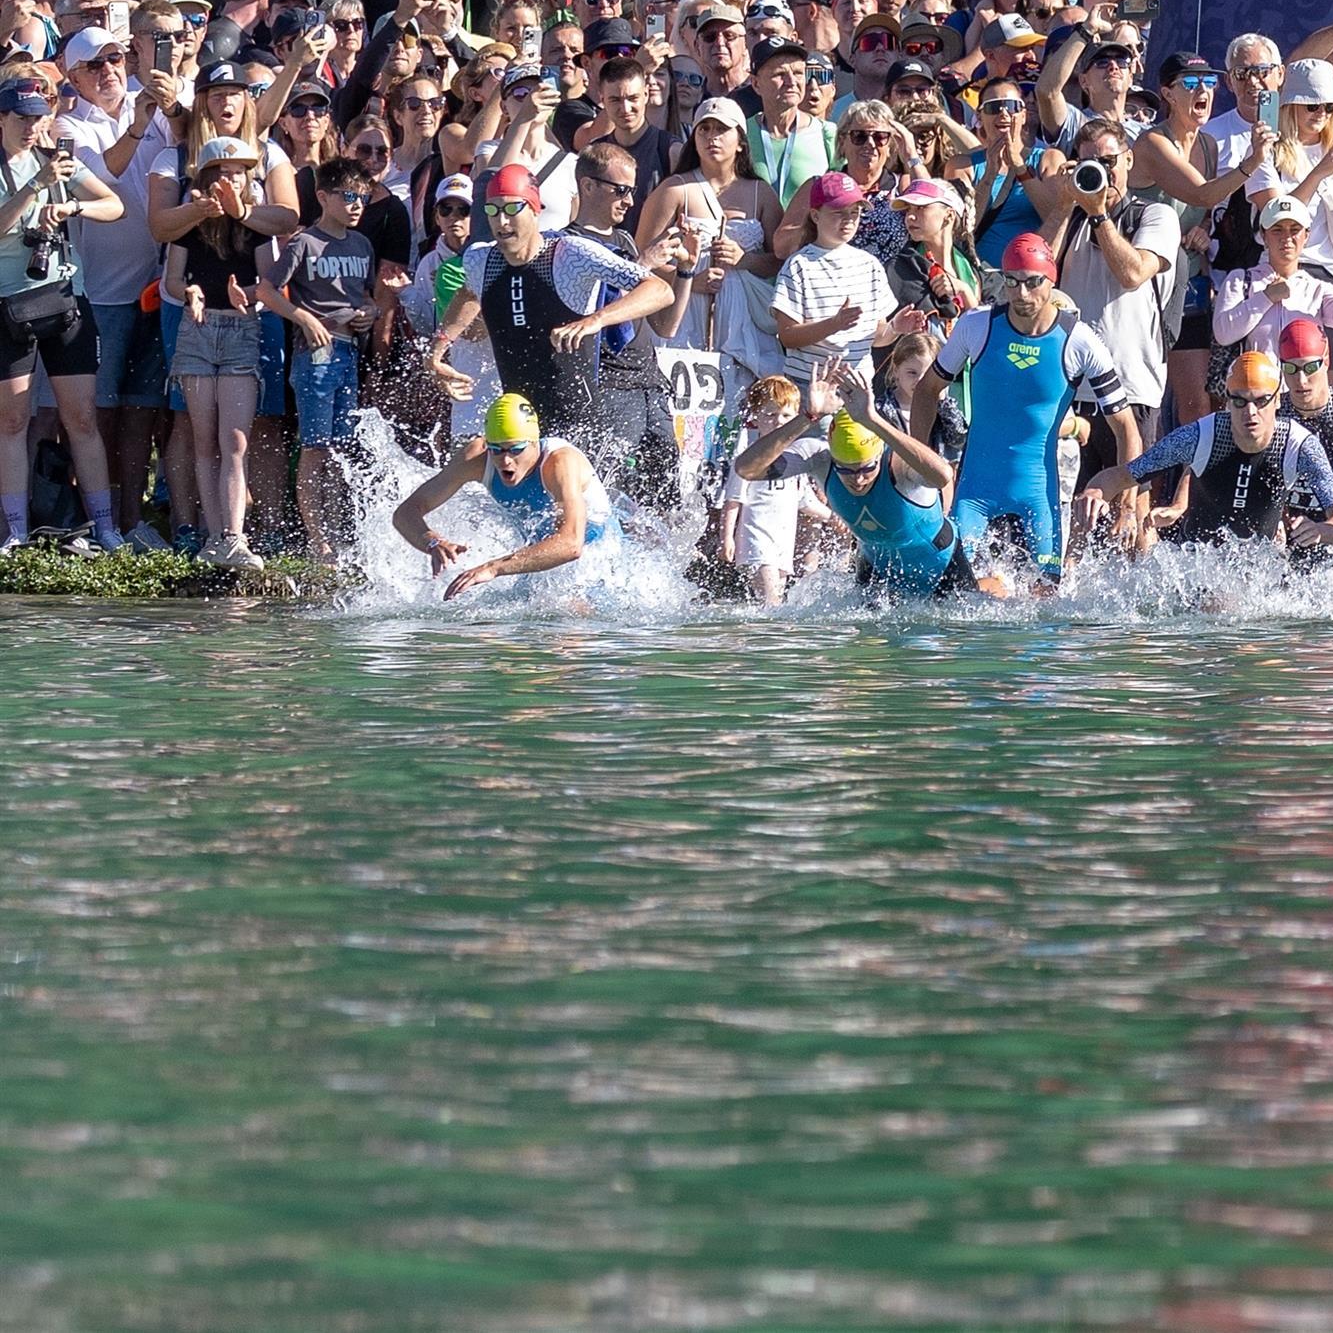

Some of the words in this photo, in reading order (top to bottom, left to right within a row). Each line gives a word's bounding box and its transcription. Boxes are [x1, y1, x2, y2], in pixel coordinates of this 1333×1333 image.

[306, 255, 371, 282] FORTNIT
[511, 276, 527, 328] HUUB
[1008, 342, 1042, 356] arena
[1232, 463, 1252, 509] HUUB
